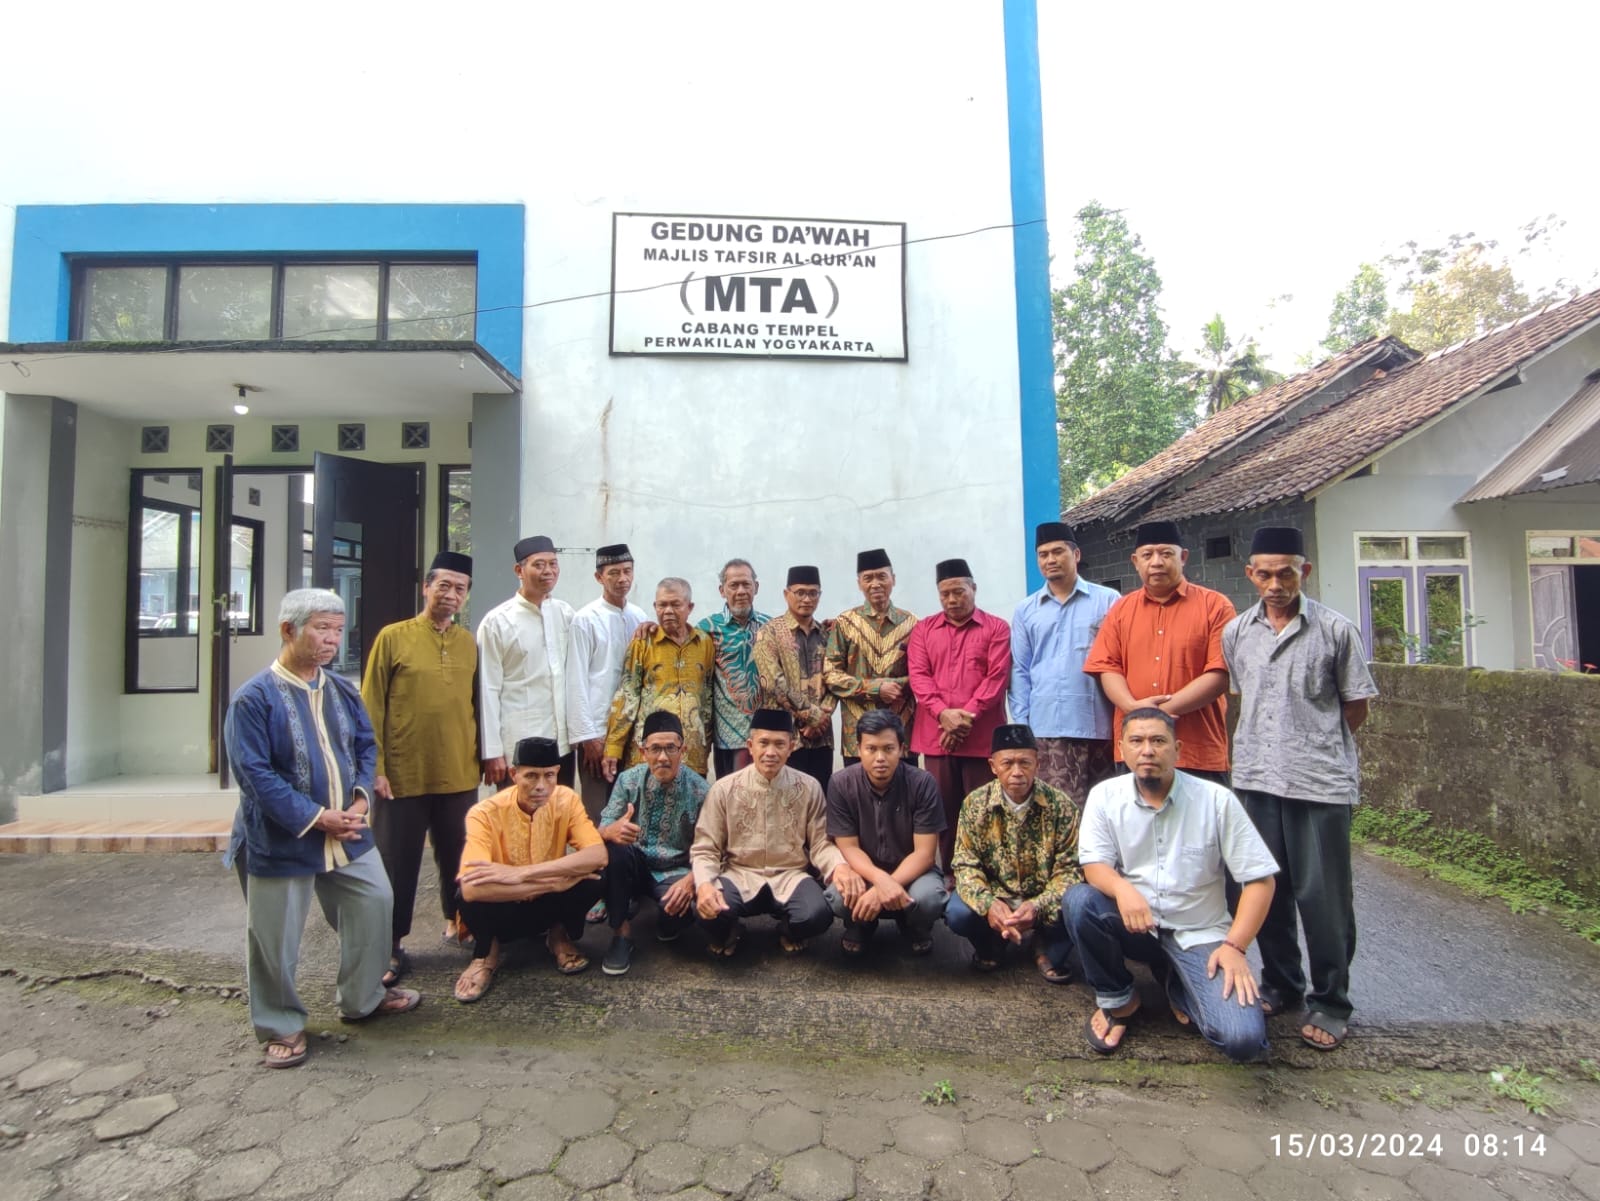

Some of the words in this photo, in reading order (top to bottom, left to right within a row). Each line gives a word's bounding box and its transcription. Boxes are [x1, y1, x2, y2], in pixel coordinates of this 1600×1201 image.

[651, 221, 763, 243] GEDUNG
[772, 225, 870, 247] DA'WAH
[643, 248, 709, 262] MAJLIS
[715, 250, 776, 265] TAFSIR
[782, 252, 876, 268] AL-QUR'AN
[681, 322, 759, 335] CABANG
[766, 324, 839, 337] TEMPEL
[644, 337, 756, 349] PERWAKILAN
[763, 339, 875, 352] YOGYAKARTA
